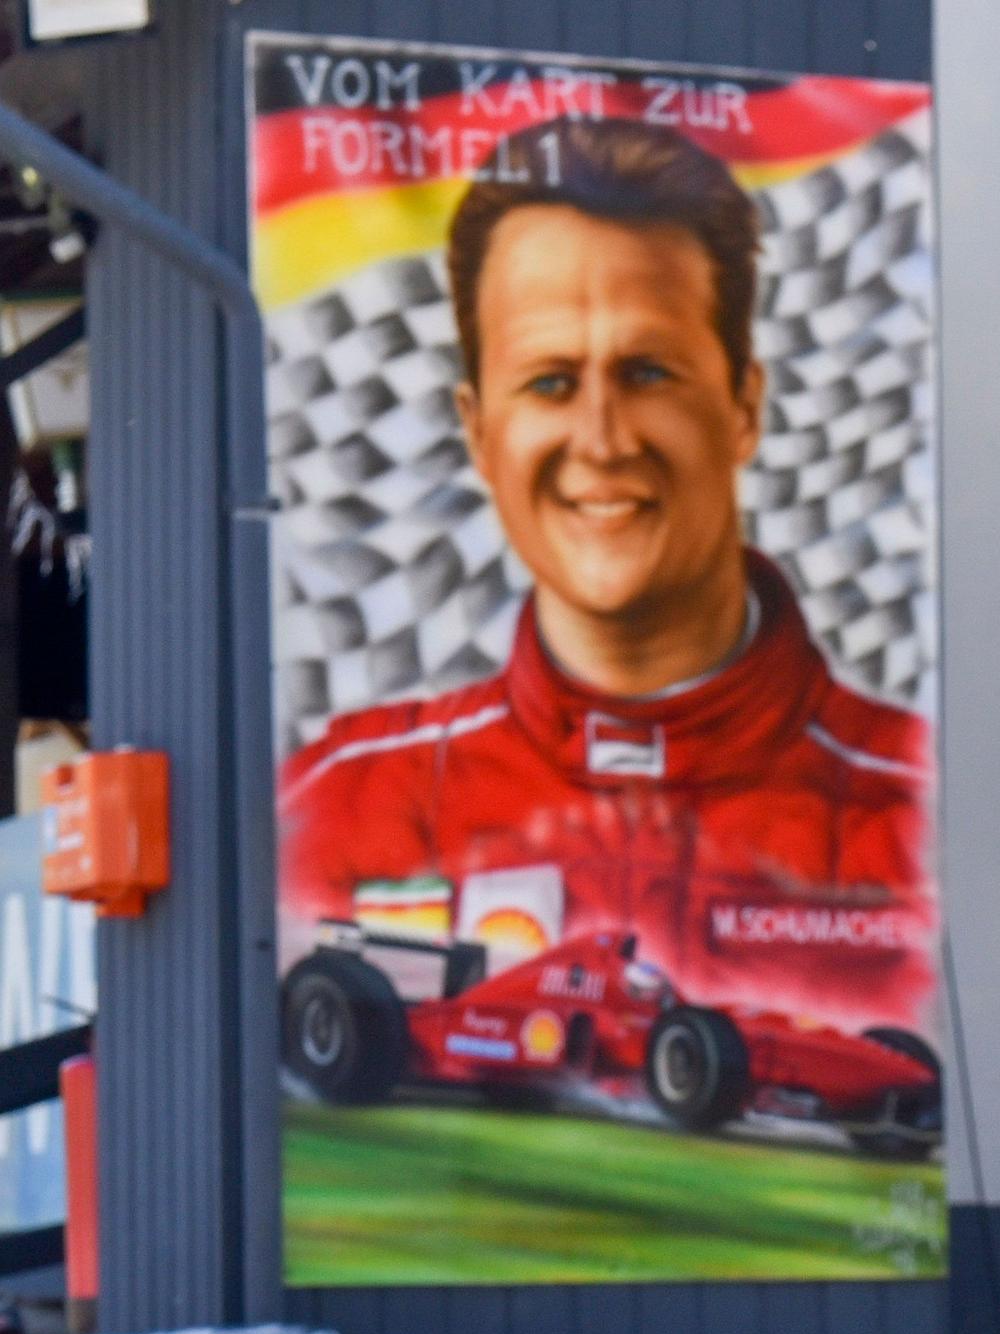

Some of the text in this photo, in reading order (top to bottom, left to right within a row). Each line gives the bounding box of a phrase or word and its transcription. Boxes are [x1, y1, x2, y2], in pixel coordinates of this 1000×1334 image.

[285, 54, 423, 113] VOM
[458, 62, 619, 122] KART
[302, 116, 563, 186] FORMEL 1
